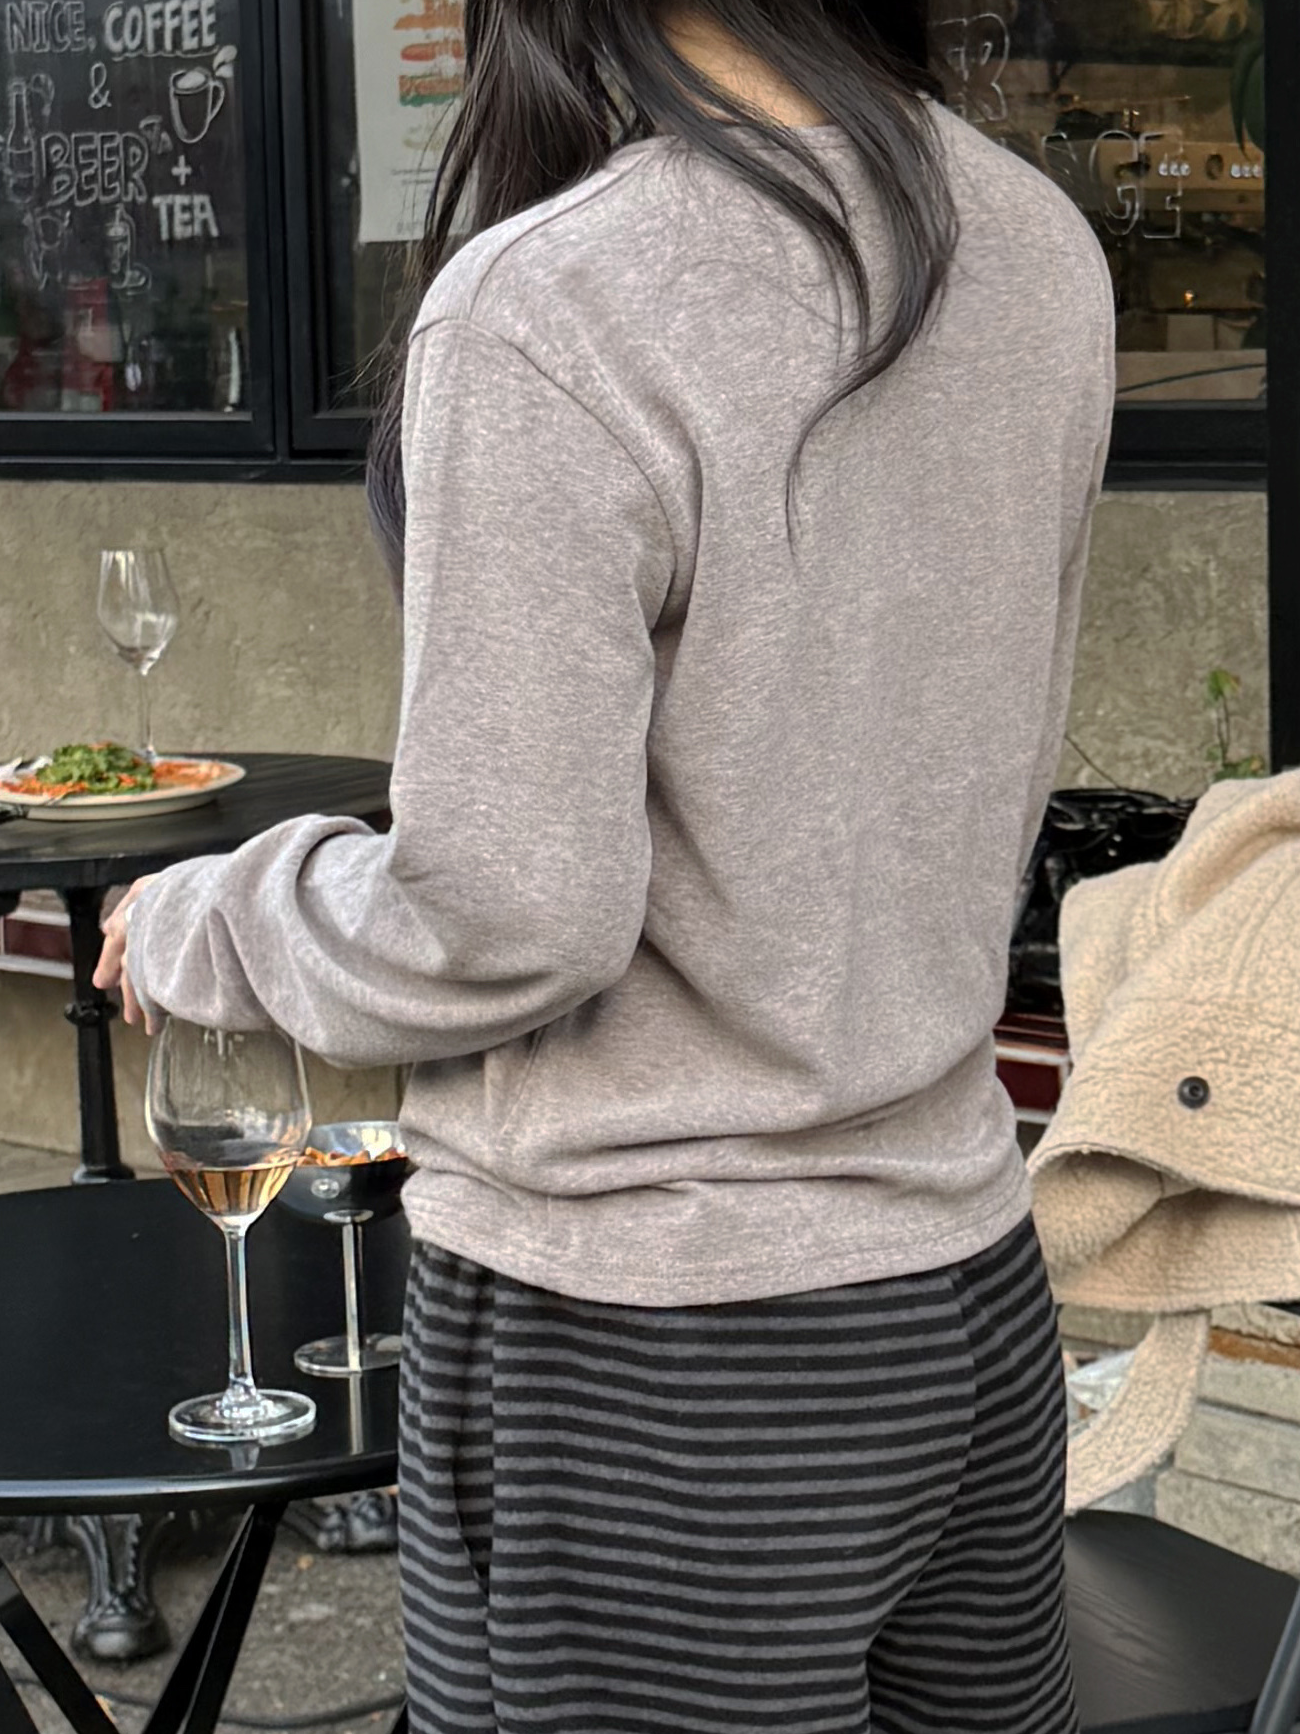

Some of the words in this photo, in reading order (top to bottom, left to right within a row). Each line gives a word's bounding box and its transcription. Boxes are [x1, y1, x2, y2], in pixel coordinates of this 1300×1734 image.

[88, 62, 113, 109] &
[40, 131, 150, 207] BEER
[152, 193, 220, 242] TEA
